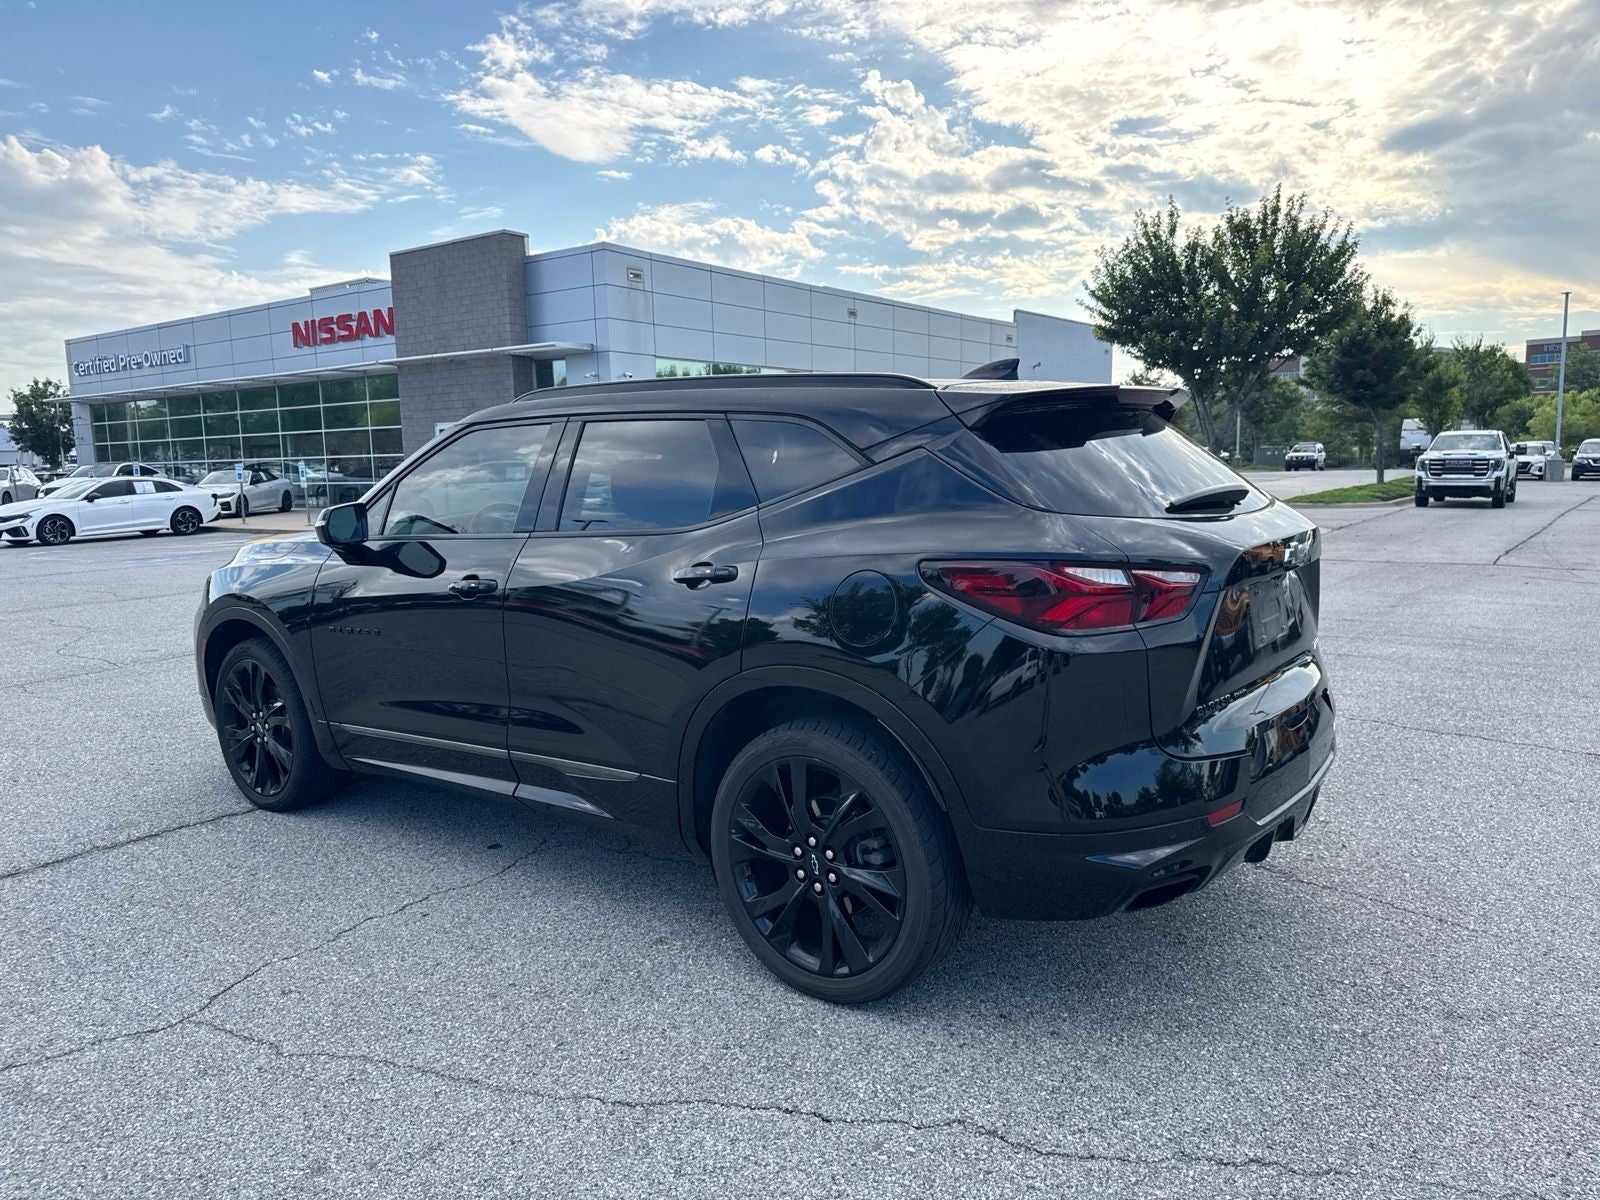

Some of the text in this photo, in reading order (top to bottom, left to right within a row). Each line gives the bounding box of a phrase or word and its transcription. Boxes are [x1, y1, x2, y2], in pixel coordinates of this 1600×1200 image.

[291, 307, 394, 348] NISSAN
[72, 343, 185, 377] Certified Pre-Owned
